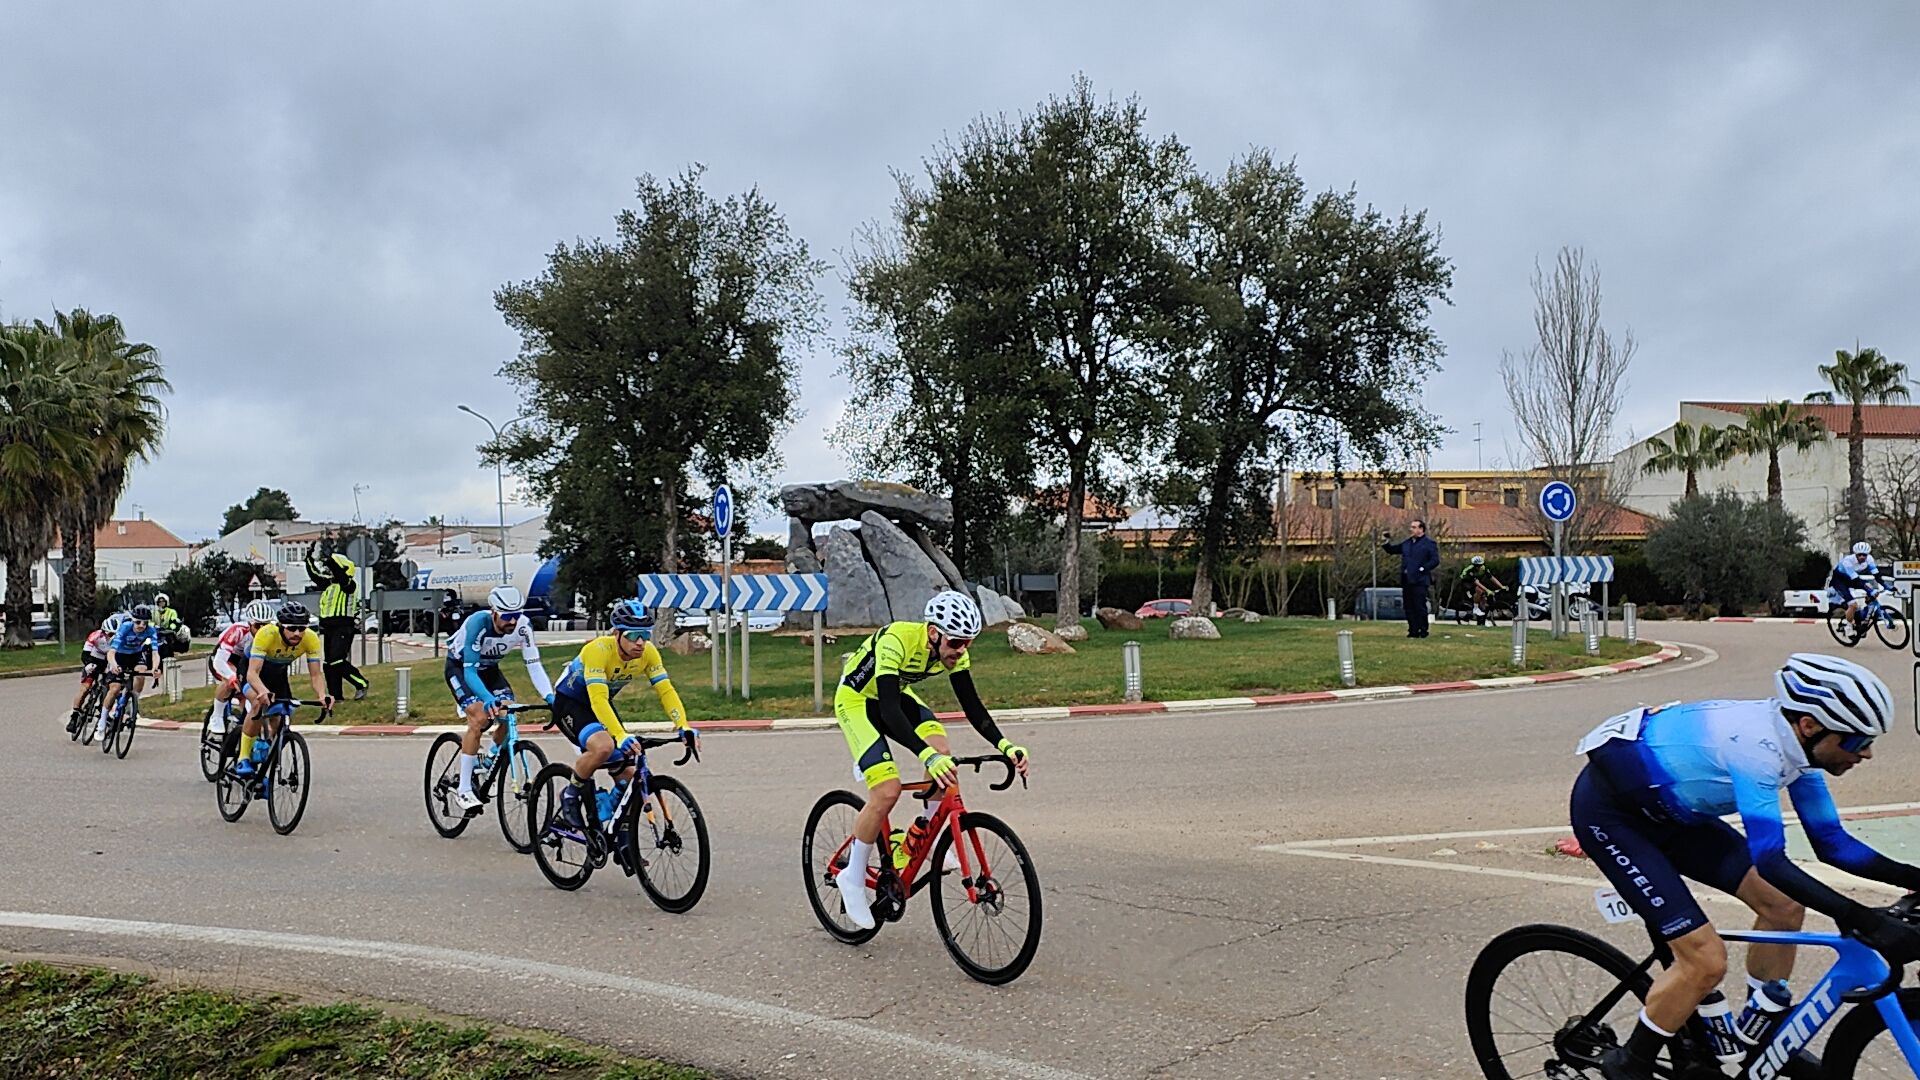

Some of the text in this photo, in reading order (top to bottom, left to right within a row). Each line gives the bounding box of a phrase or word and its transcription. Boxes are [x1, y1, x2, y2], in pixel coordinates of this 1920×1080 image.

[1588, 824, 1665, 908] AC HOTELS
[1748, 978, 1836, 1080] GIANT
